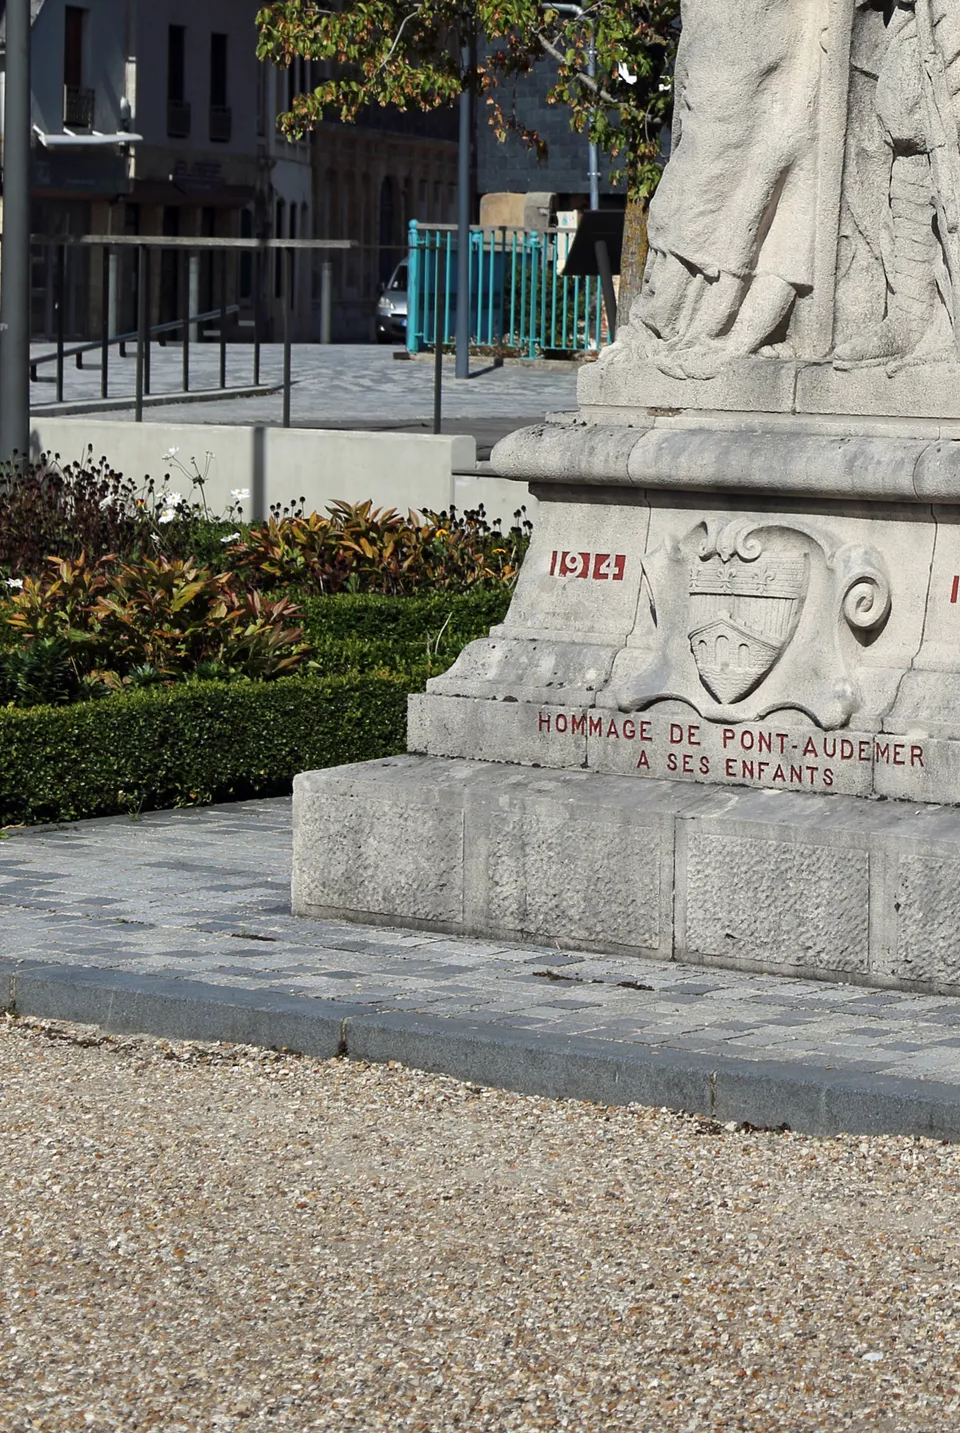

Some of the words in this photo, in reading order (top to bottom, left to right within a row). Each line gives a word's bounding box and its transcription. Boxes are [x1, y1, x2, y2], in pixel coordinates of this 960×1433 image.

[550, 551, 626, 581] 1914
[538, 711, 655, 743] HOMMAGE
[669, 724, 702, 746] DE
[722, 729, 926, 768] PONT-AUDEMER
[636, 750, 650, 770] A
[667, 755, 710, 775] SES
[725, 759, 835, 787] ENFANTS
